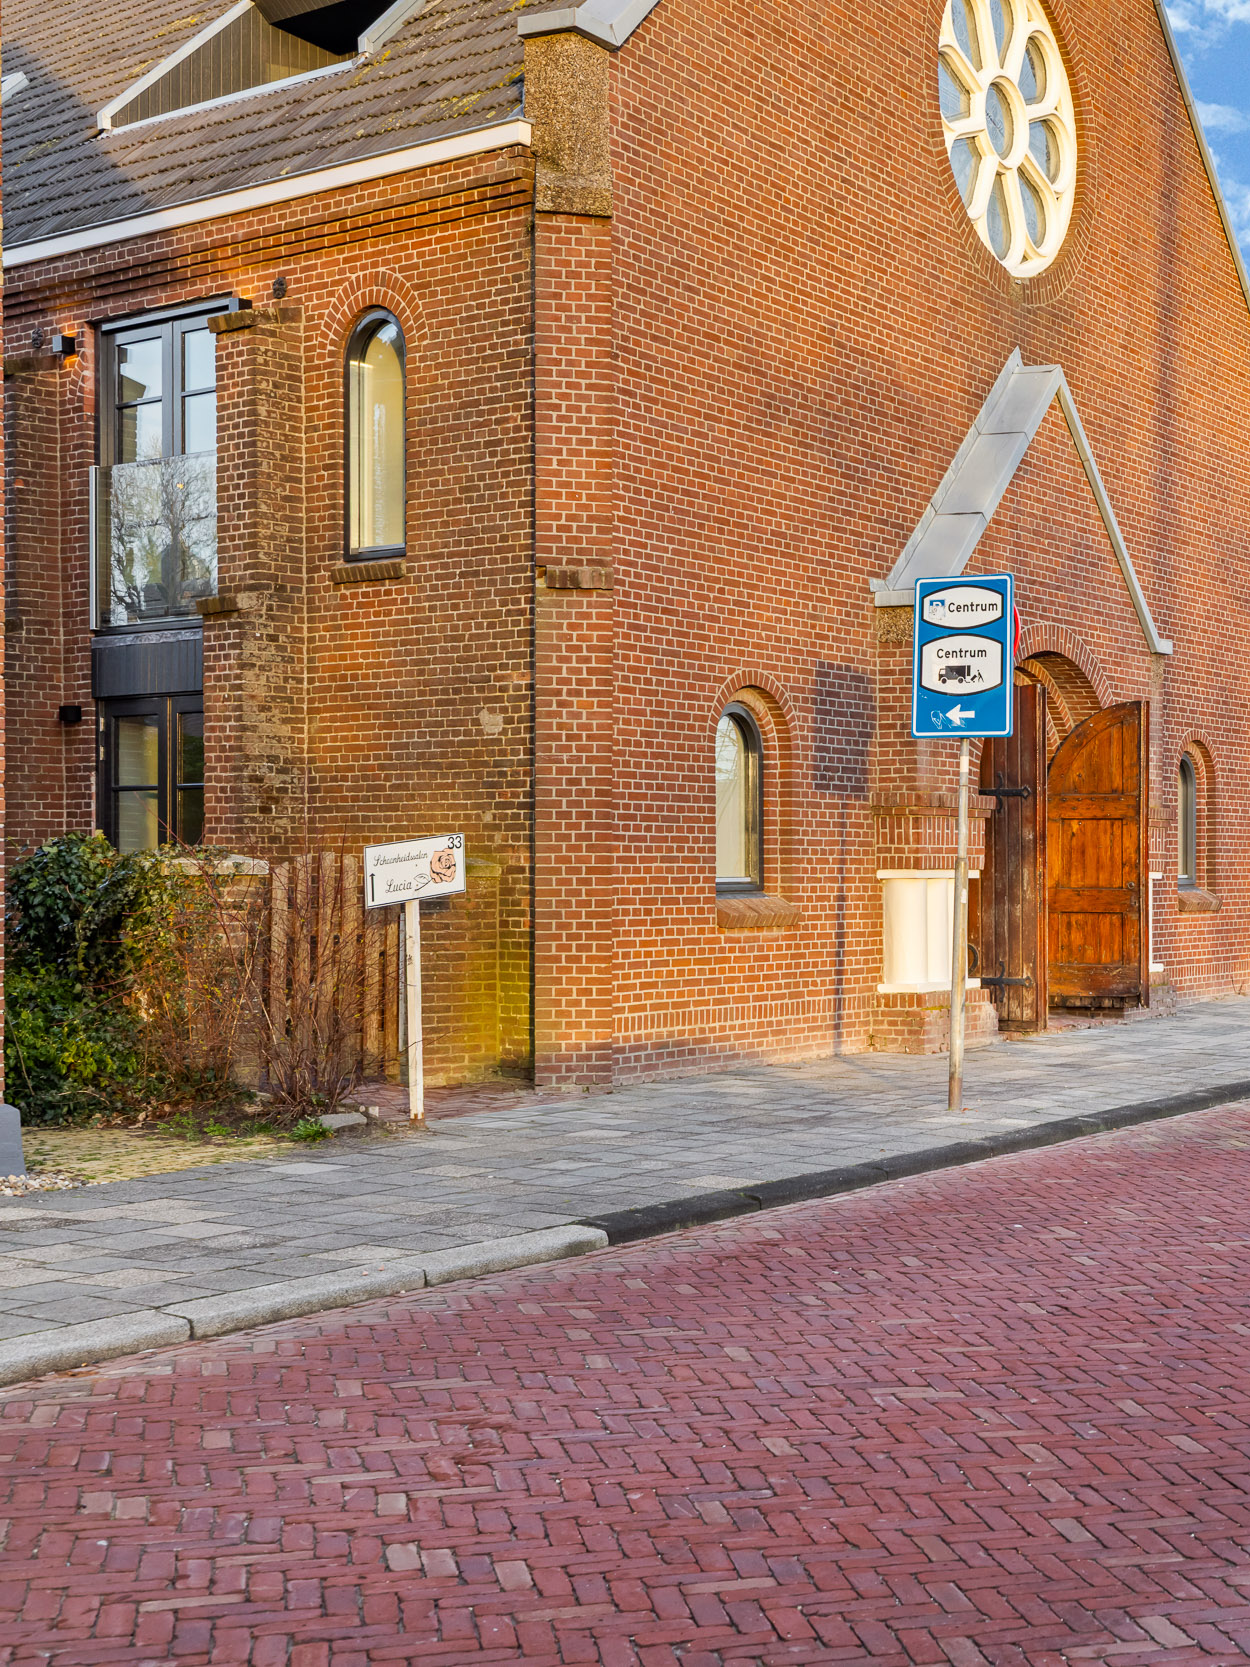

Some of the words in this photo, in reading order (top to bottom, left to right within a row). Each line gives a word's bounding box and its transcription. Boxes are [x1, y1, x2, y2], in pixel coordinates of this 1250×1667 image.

[948, 602, 998, 613] Centrum
[936, 648, 987, 659] Centrum
[447, 835, 462, 849] 33
[385, 879, 412, 893] Lucia
